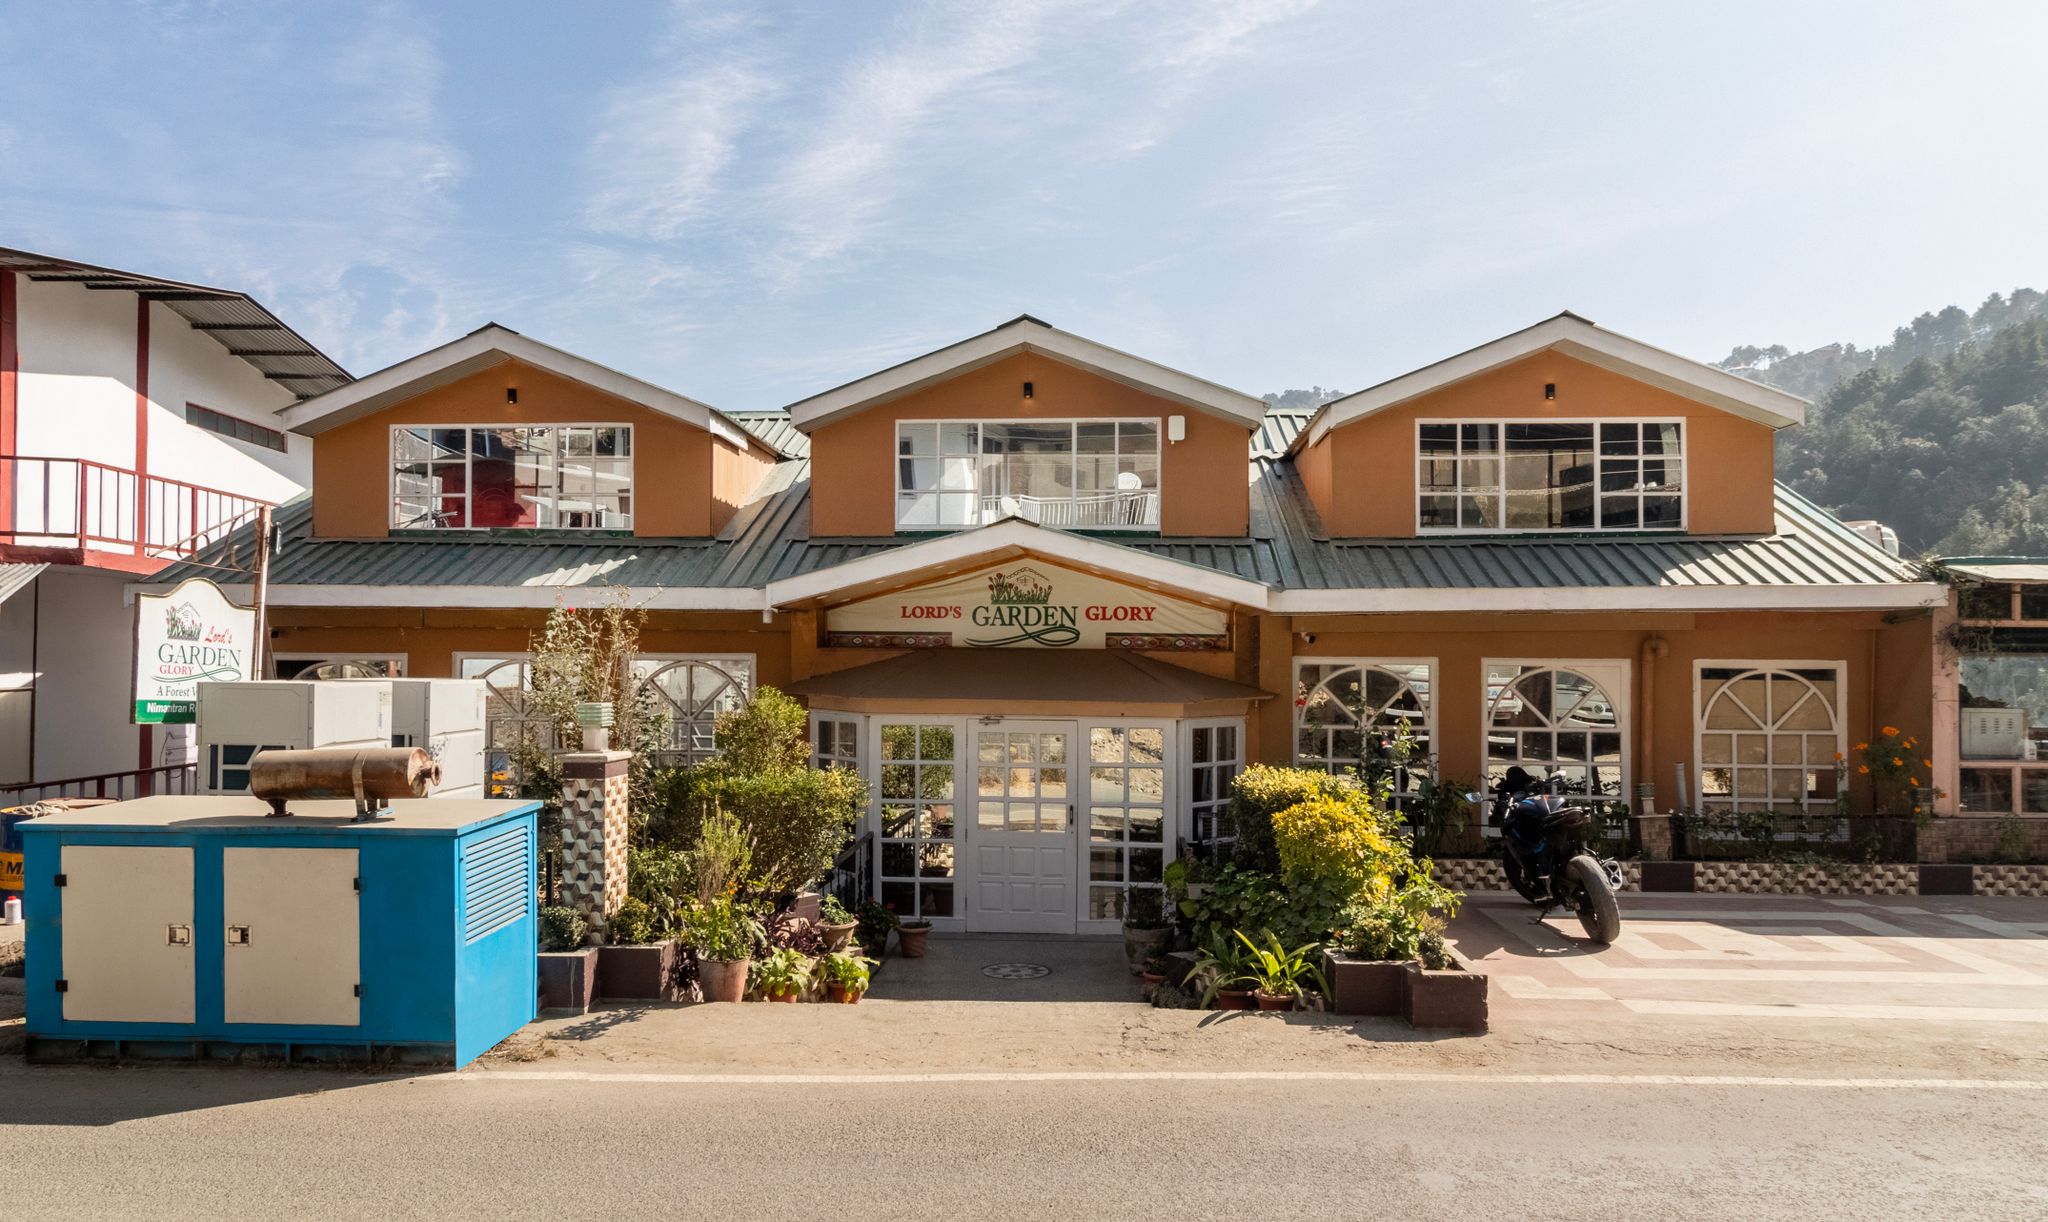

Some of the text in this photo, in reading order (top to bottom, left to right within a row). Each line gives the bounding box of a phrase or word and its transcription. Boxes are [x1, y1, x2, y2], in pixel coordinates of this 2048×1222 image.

[901, 605, 1157, 628] LORD'S GARDEN GLORY
[205, 626, 232, 644] Lord's
[158, 643, 242, 667] GARDEN
[160, 664, 194, 676] GLORY
[156, 685, 164, 696] A
[165, 686, 190, 697] Forest
[147, 702, 187, 713] Nimantran
[6, 861, 24, 875] M
